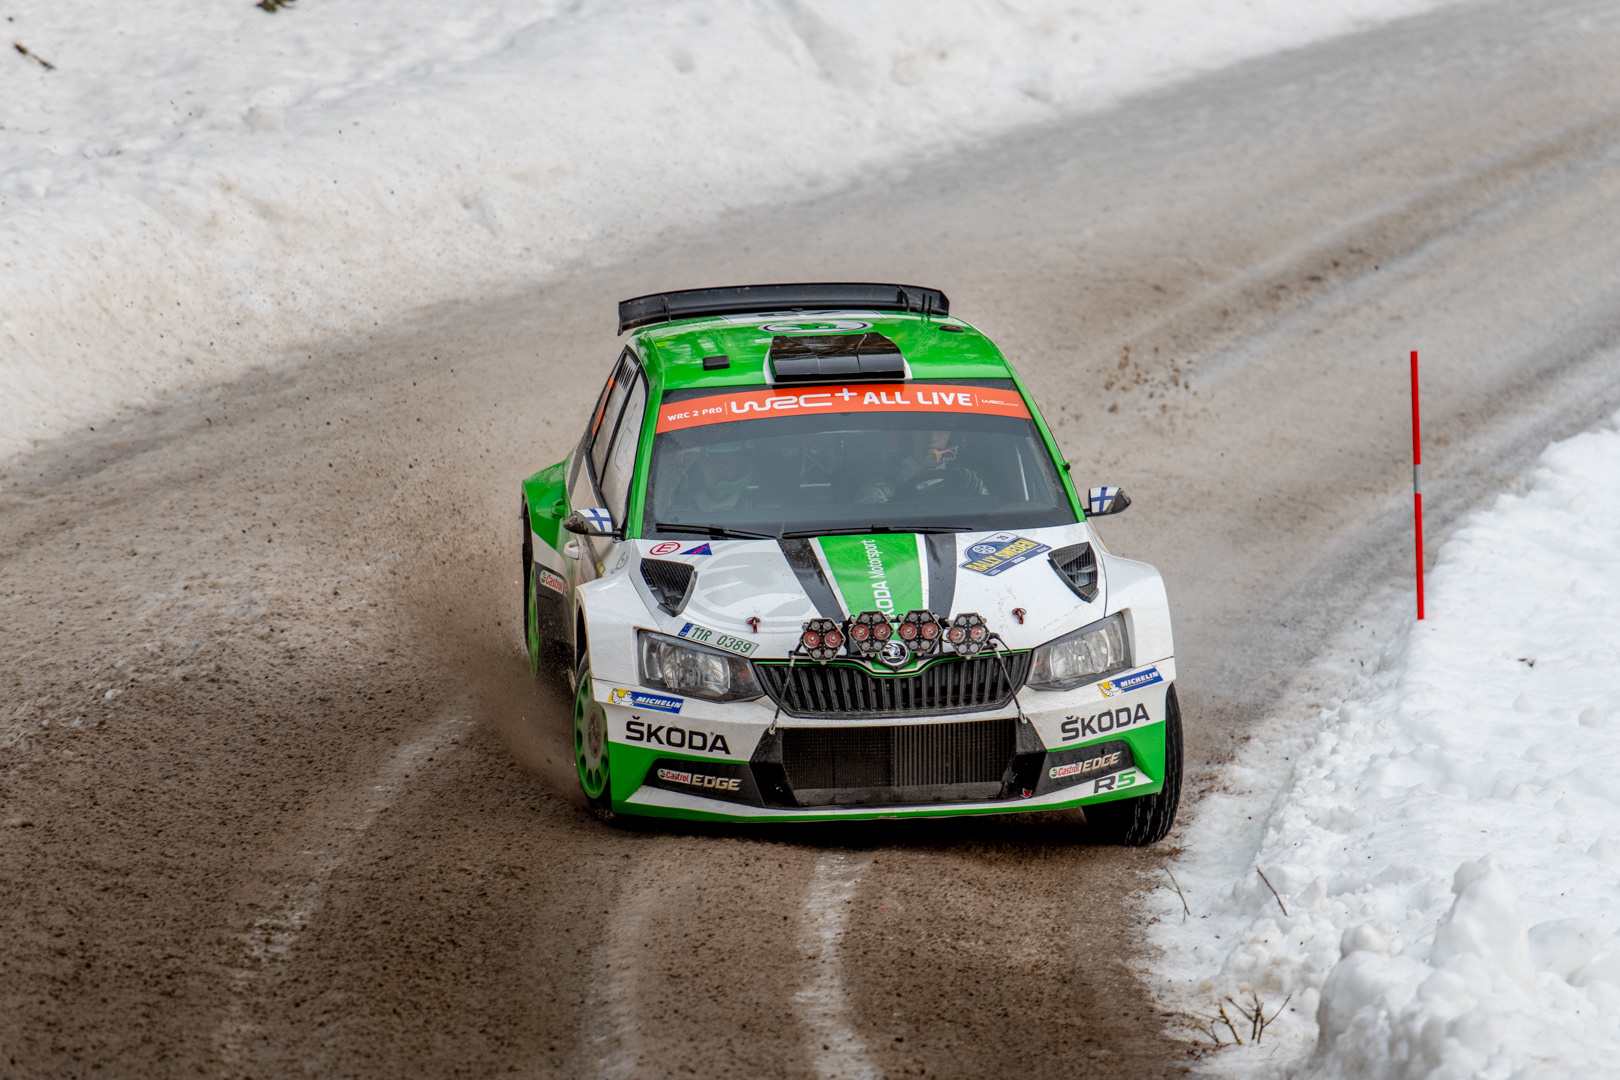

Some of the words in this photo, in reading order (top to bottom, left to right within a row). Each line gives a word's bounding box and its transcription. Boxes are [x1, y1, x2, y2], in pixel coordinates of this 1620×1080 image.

[863, 391, 910, 405] ALL
[917, 391, 973, 407] LIVE
[667, 411, 690, 421] WRC
[702, 406, 723, 416] PRO
[860, 539, 886, 579] Motorsport
[964, 555, 1003, 572] RALLY
[994, 538, 1039, 559] SWEDEN
[546, 574, 563, 591] Castrol
[871, 580, 897, 620] KODA
[691, 627, 713, 641] 11R
[716, 635, 752, 653] 0389
[1120, 671, 1159, 687] MICHELIN
[636, 696, 682, 709] MICHELIN
[1061, 703, 1150, 741] ŠKODA
[626, 716, 731, 755] ŠKODA
[1058, 763, 1079, 776] Castrol
[1081, 751, 1122, 772] EDGE
[665, 770, 690, 783] Castrol
[691, 774, 743, 791] EDGE
[1093, 770, 1137, 794] R5
